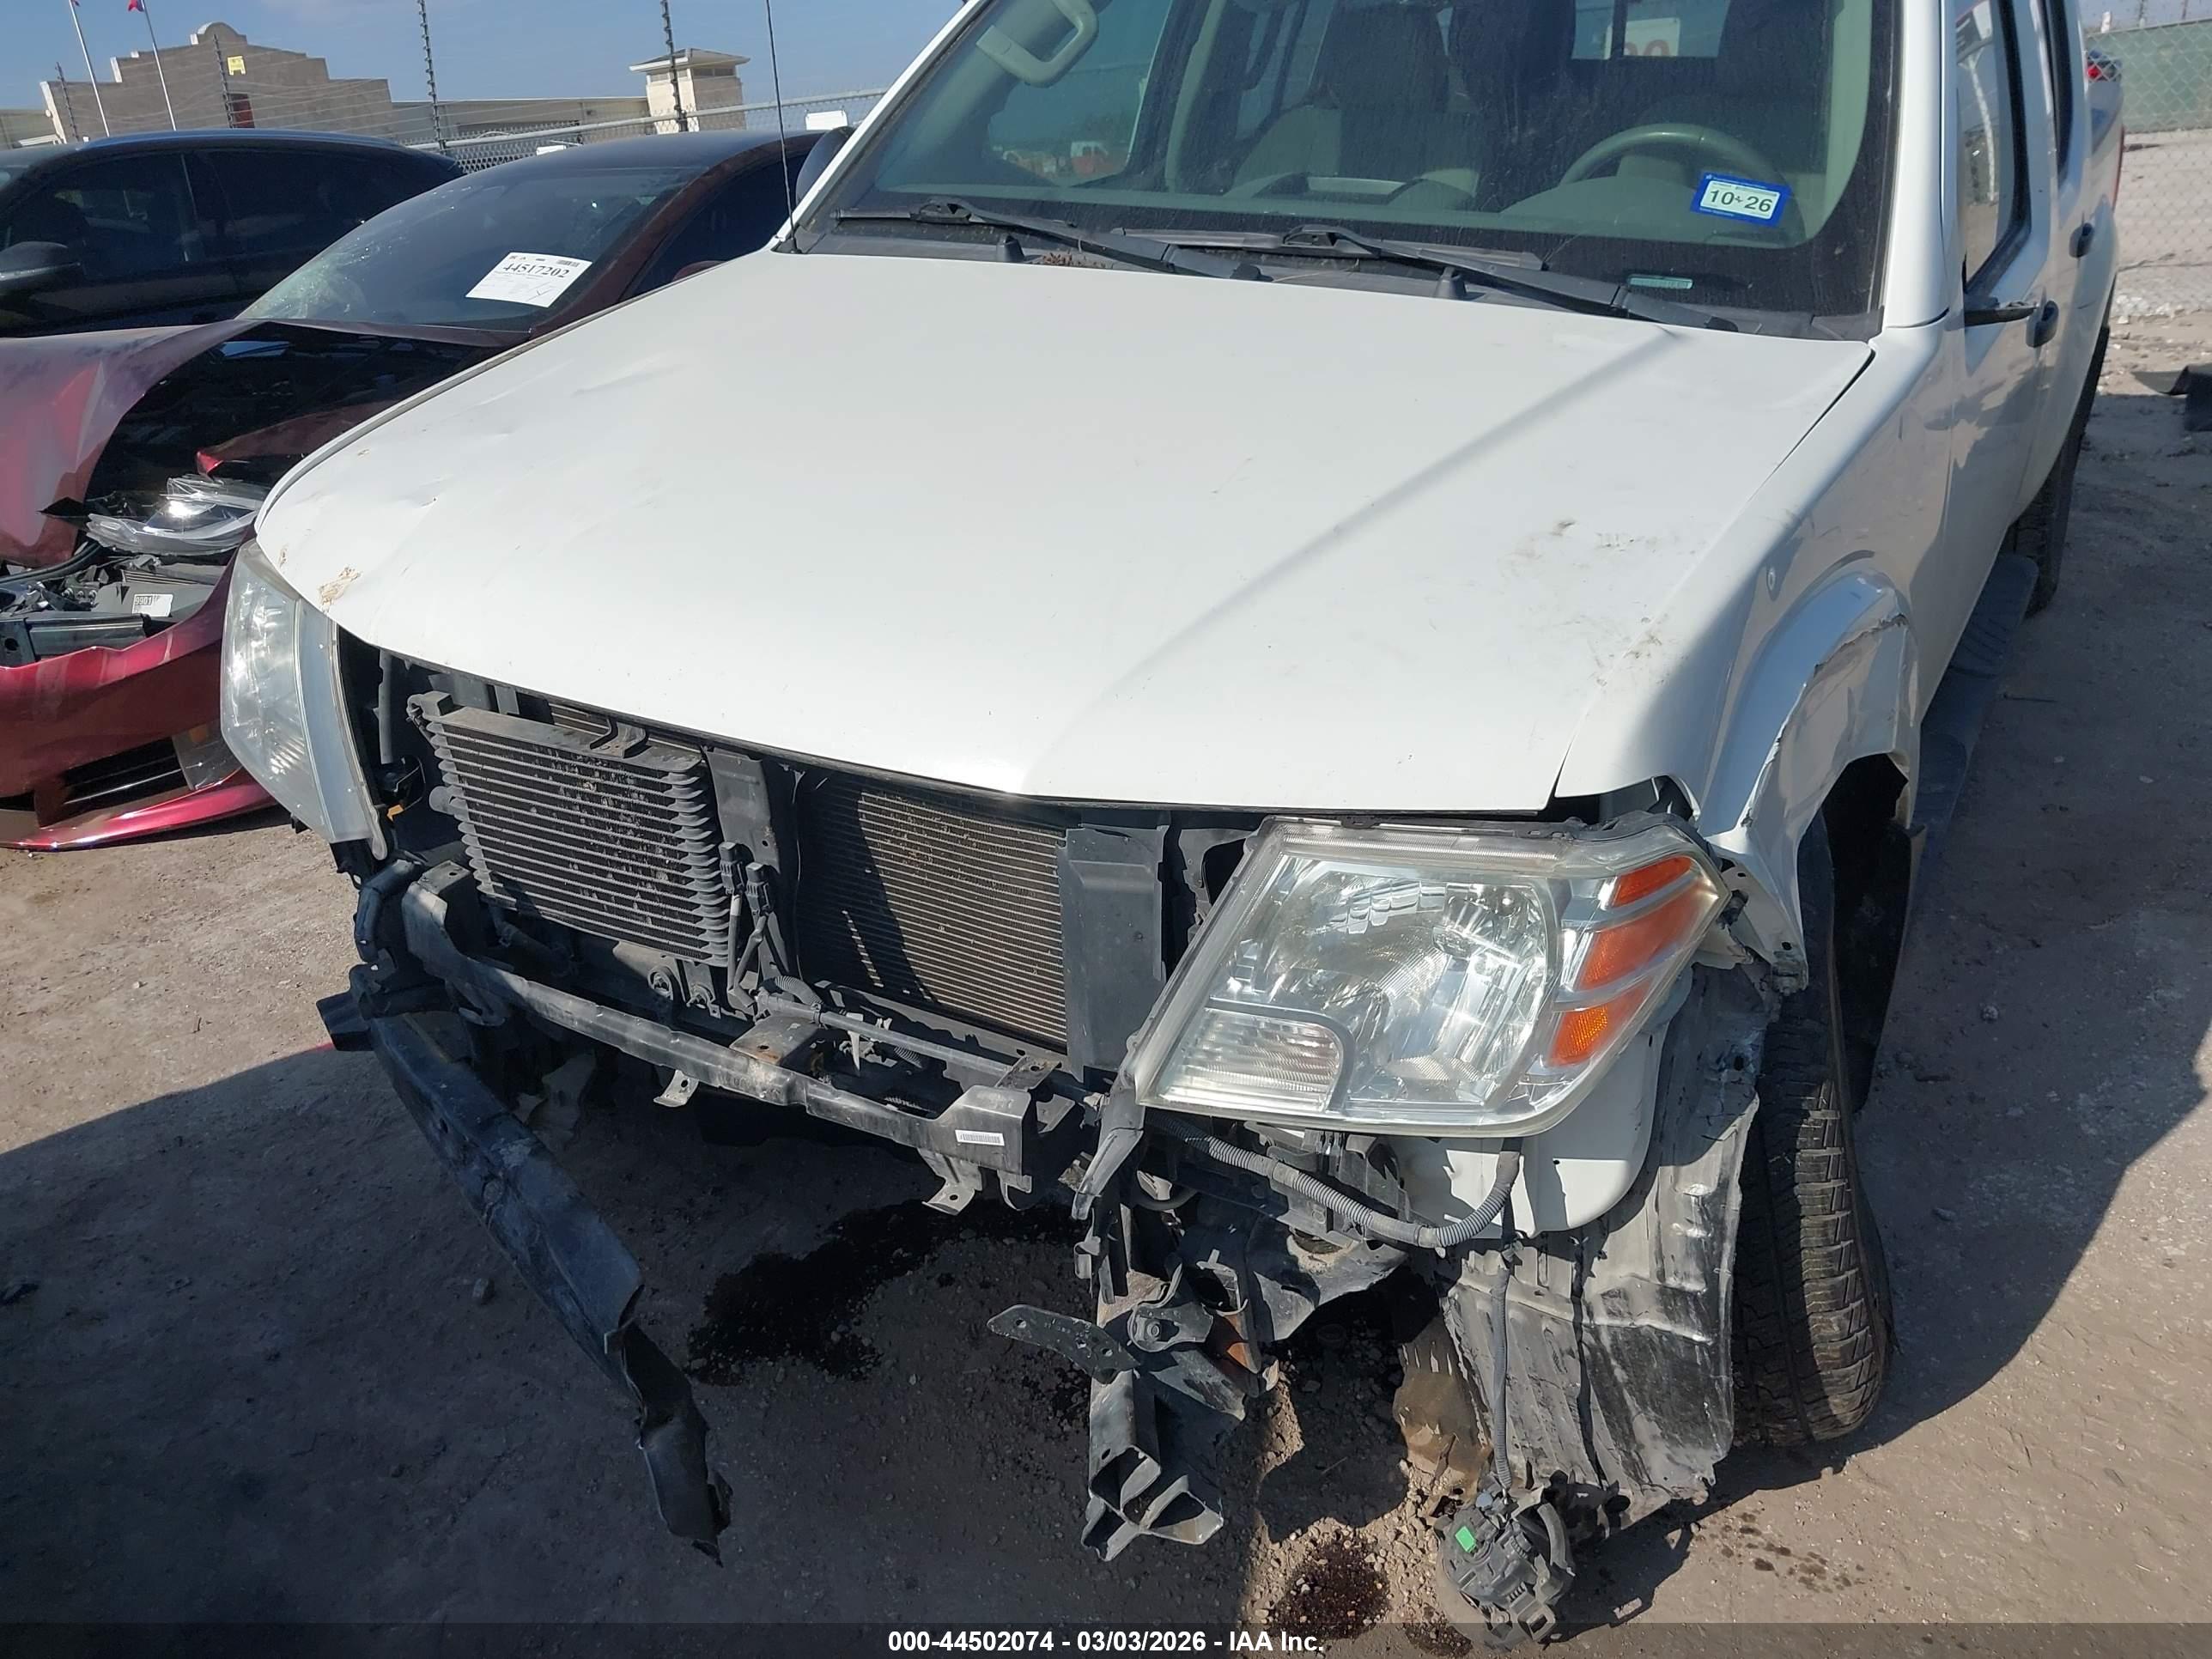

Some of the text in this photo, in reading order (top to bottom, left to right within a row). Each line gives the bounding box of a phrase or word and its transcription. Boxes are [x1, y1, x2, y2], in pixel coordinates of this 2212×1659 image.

[1710, 189, 1773, 212] 10 26
[503, 262, 570, 278] 44517202
